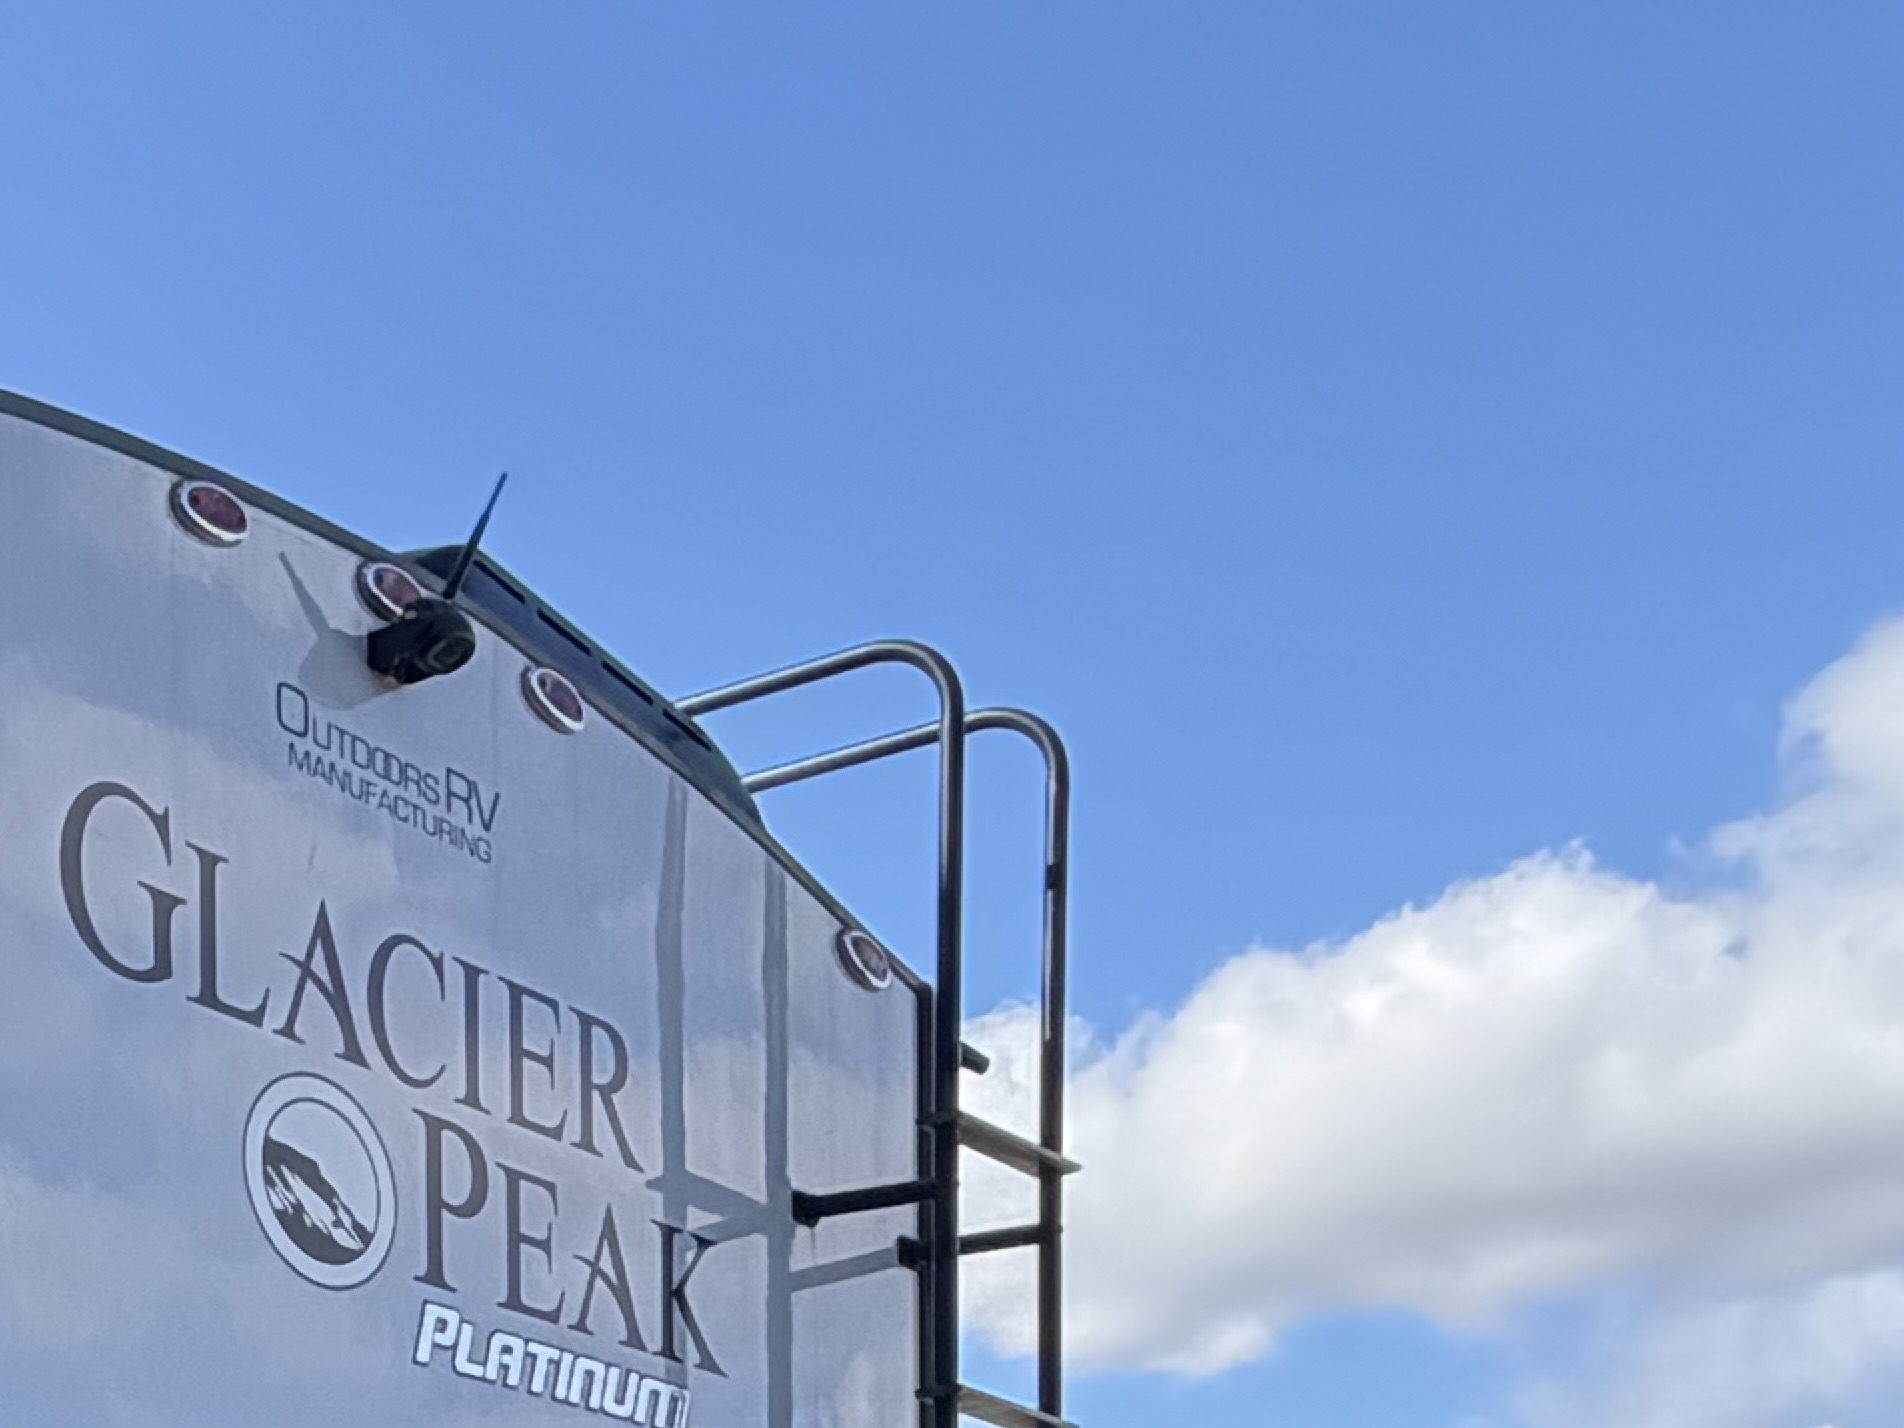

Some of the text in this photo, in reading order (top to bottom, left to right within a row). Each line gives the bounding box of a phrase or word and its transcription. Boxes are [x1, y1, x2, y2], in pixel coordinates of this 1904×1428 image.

[288, 742, 493, 864] MANUFACTURING
[59, 781, 645, 1174] GLACIER
[412, 1108, 730, 1379] PEAK
